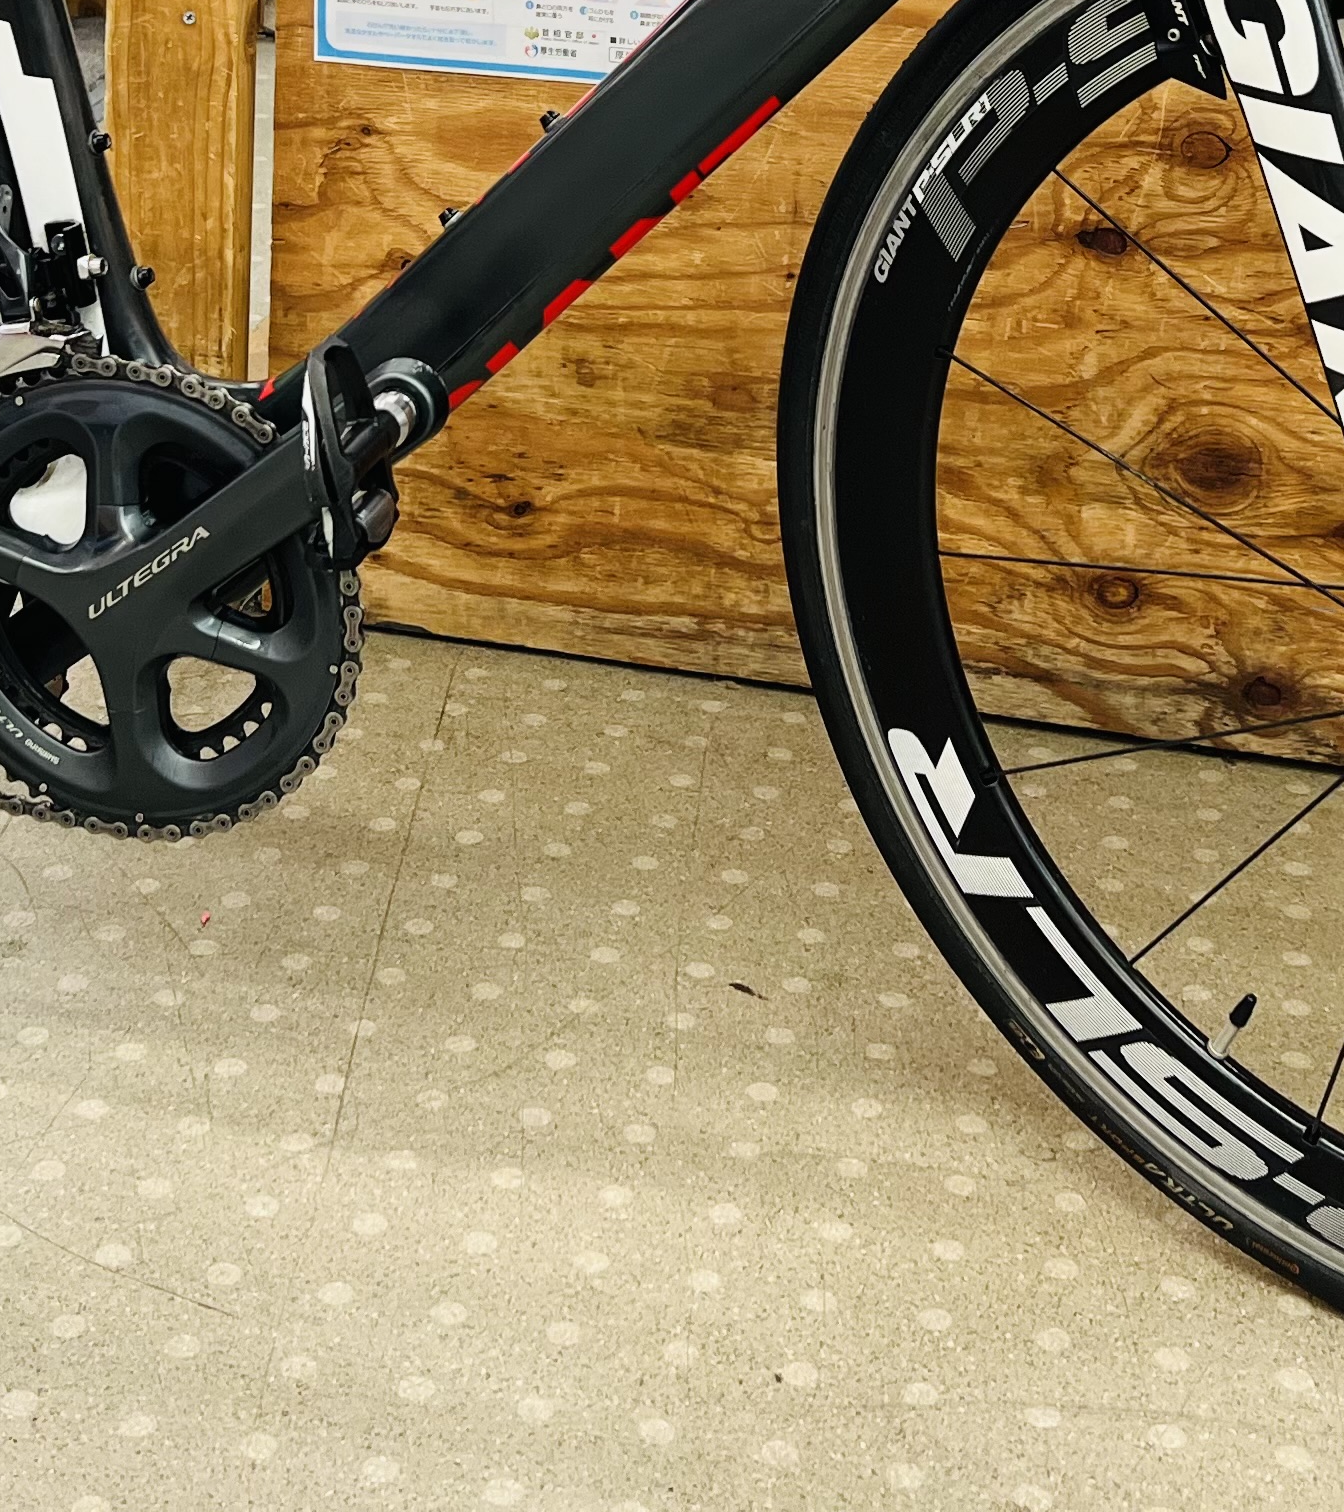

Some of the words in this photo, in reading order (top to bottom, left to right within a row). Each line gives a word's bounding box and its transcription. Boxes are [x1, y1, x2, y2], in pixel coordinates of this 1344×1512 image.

[872, 196, 920, 285] GIANT
[87, 524, 211, 621] ULTEGRA
[1143, 1160, 1234, 1230] ULTRA
